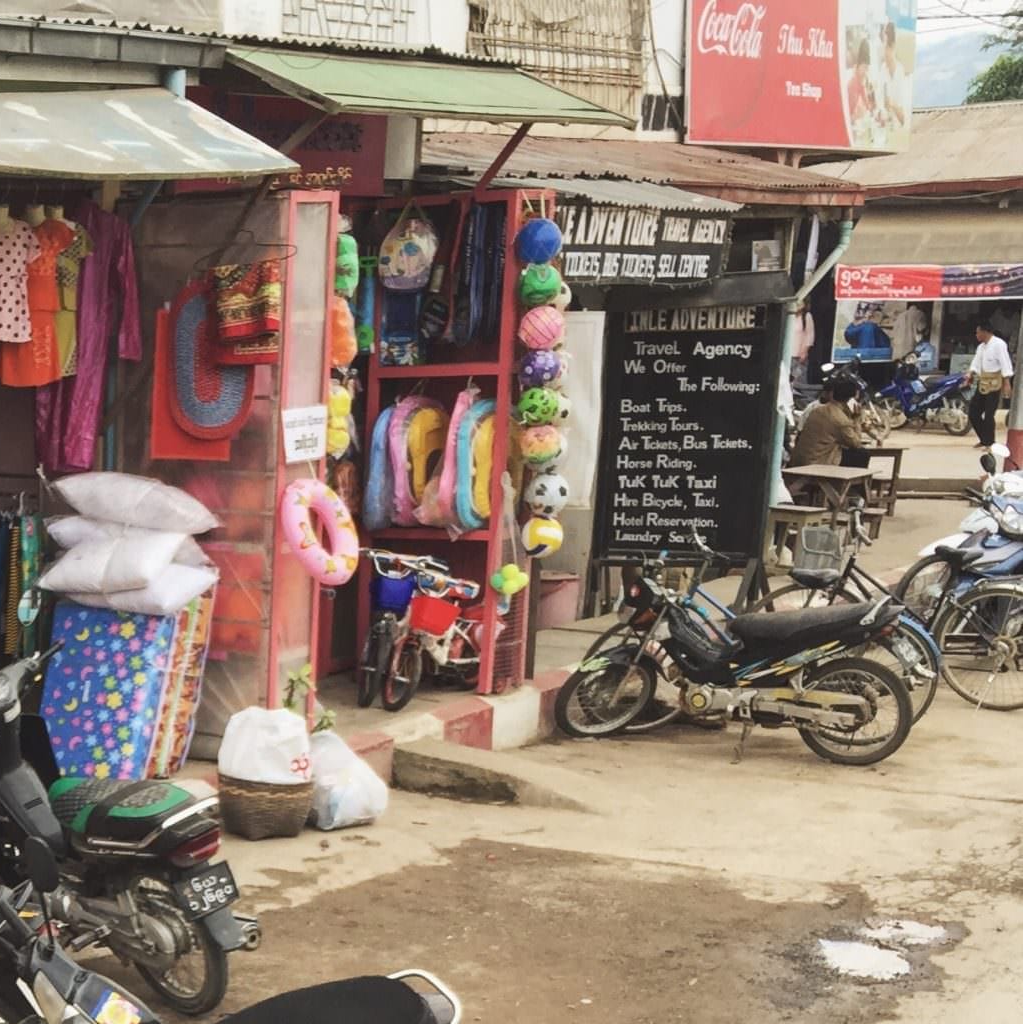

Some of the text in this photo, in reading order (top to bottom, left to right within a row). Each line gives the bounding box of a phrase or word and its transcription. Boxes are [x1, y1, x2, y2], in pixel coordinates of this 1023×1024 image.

[777, 24, 833, 58] Thu Kha
[802, 82, 822, 102] Shop
[662, 216, 691, 243] TRAVEL
[691, 219, 727, 244] AGENCY
[657, 254, 677, 278] SELL
[630, 306, 756, 331] INLE ADVENTURE
[692, 341, 752, 359] Agency
[624, 359, 686, 374] We Offer
[678, 377, 761, 395] The Following:
[620, 398, 687, 415] Boat Trips.
[620, 417, 704, 434] Trekking Tours.
[618, 436, 640, 450] Air
[683, 434, 707, 450] Bus
[710, 434, 752, 450] Tickets.
[616, 454, 697, 472] Horse Riding.
[686, 475, 717, 489] Taxi
[614, 493, 638, 508] Hire
[692, 492, 719, 508] Taxi.
[613, 512, 719, 528] Hotel Reservation.
[615, 529, 707, 544] Laundry Serve
